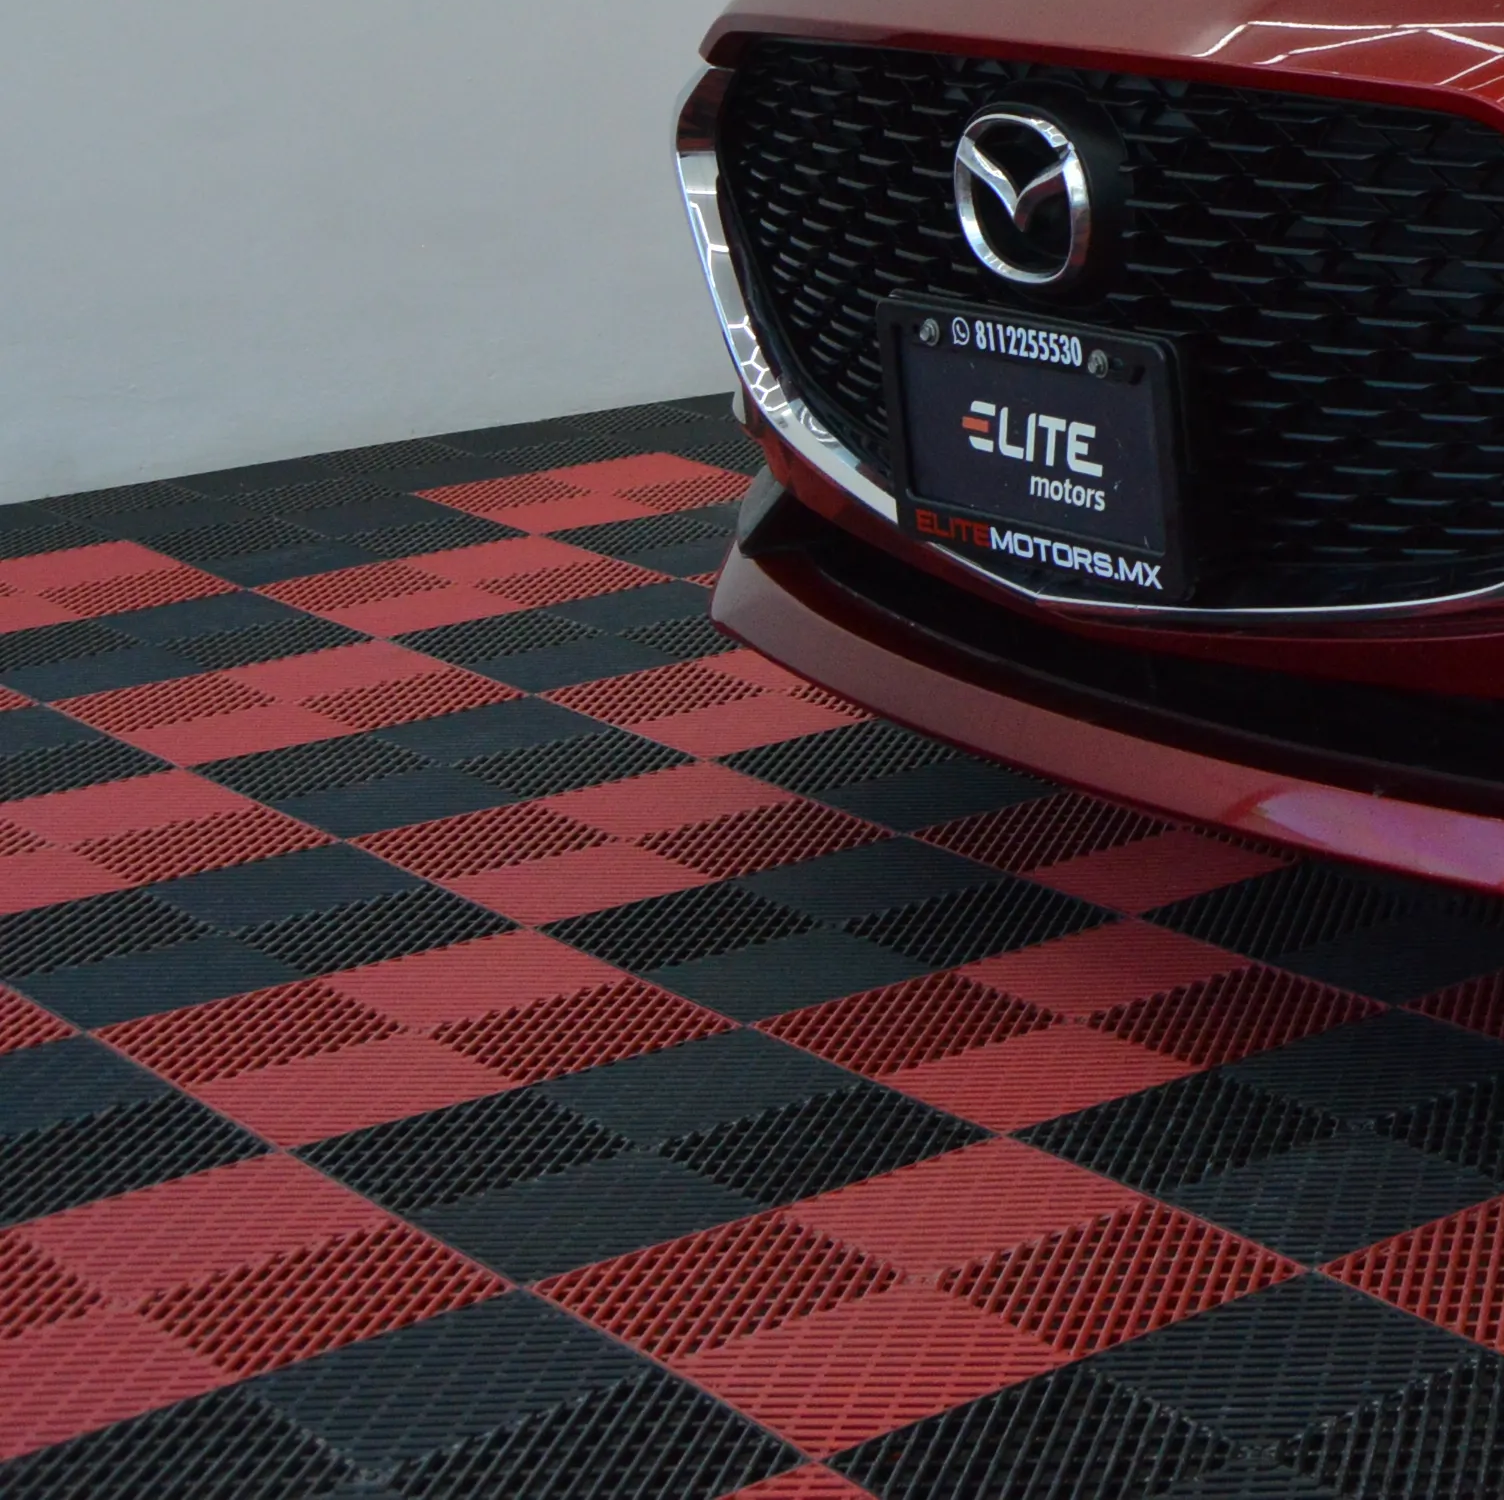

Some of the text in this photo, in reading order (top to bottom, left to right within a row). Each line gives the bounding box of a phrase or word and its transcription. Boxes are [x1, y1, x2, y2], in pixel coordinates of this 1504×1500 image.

[975, 320, 1083, 366] 8112255530
[962, 400, 1103, 477] ELITE
[1030, 475, 1106, 511] motors
[915, 508, 1163, 590] ELITEMOTORS.MX
